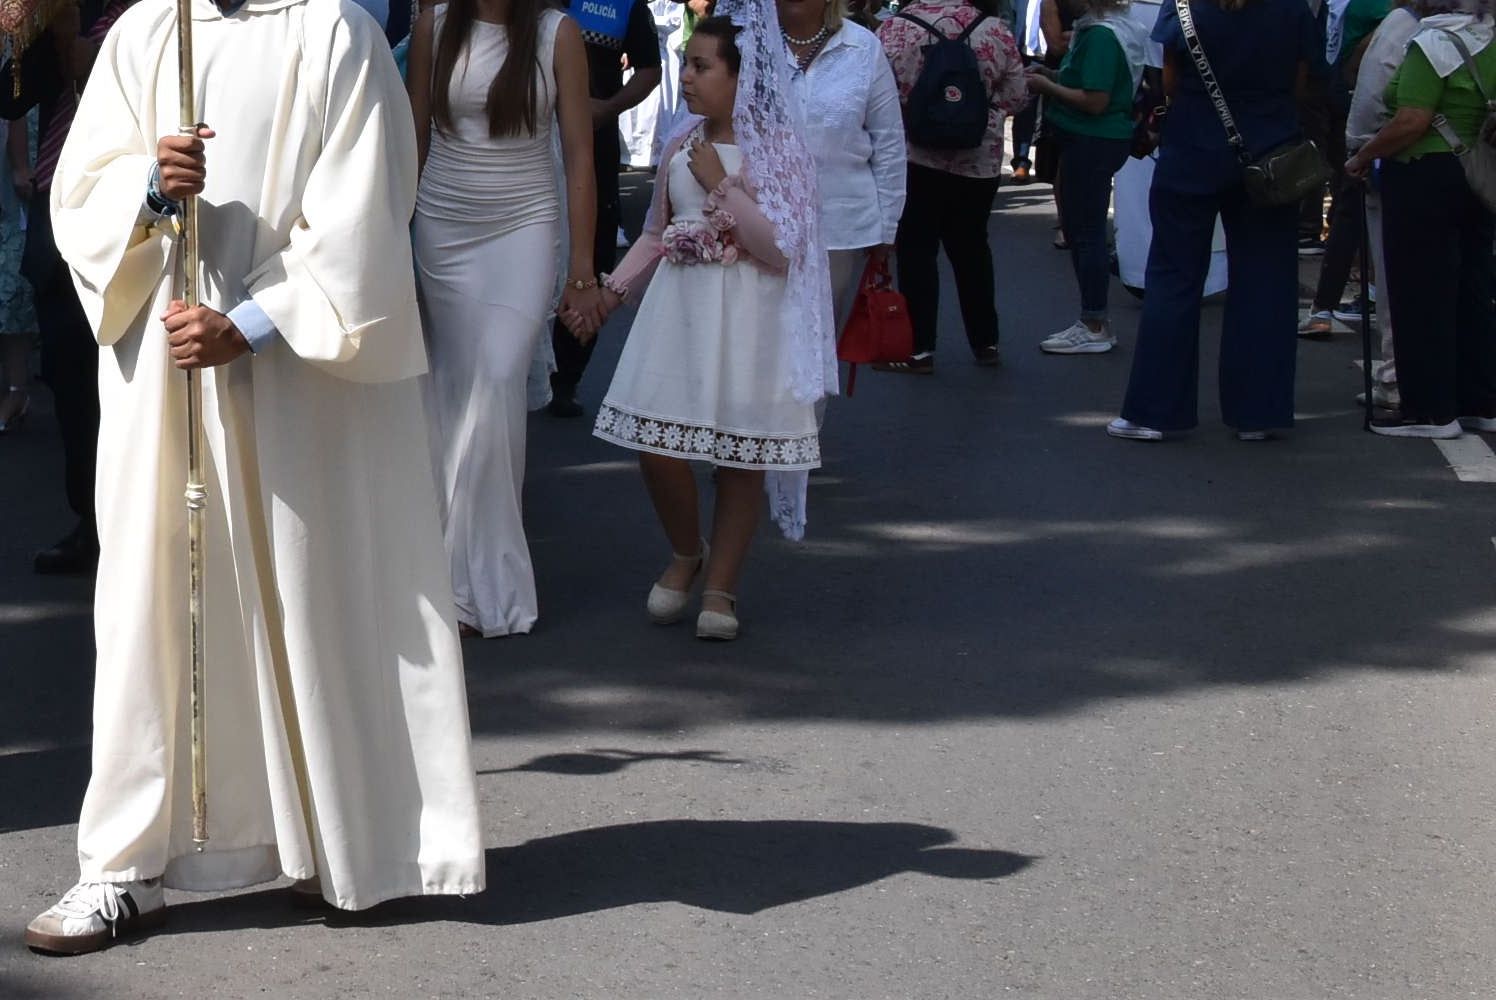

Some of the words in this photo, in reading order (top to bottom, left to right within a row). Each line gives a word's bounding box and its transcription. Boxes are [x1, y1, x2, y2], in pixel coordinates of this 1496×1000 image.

[582, 1, 616, 20] POLICÍA
[1192, 43, 1212, 77] LOLA
[1205, 79, 1216, 87] Y
[1211, 88, 1234, 128] BIMBA
